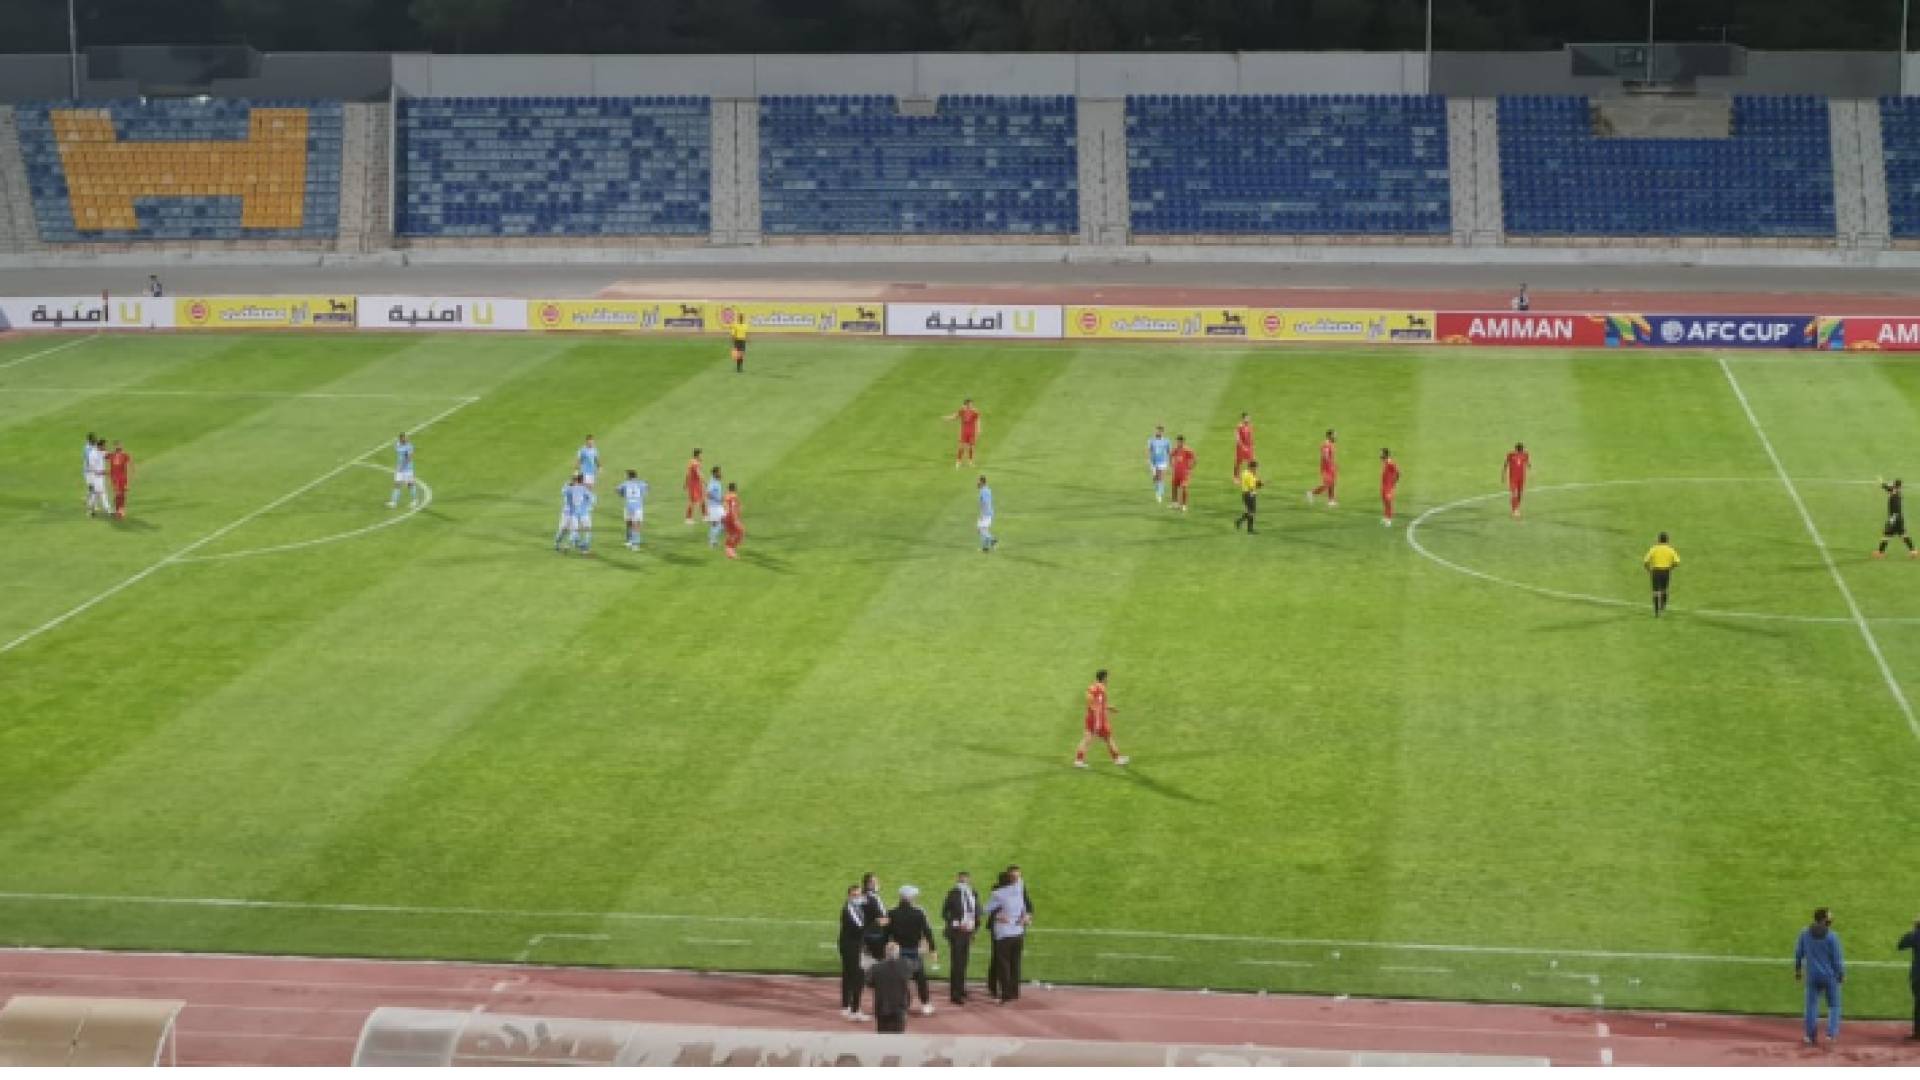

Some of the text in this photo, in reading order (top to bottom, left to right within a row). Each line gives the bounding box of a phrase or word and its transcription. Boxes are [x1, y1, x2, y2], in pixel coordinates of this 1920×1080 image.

[1468, 317, 1573, 339] AMMAN
[1687, 322, 1789, 341] AFC CUP
